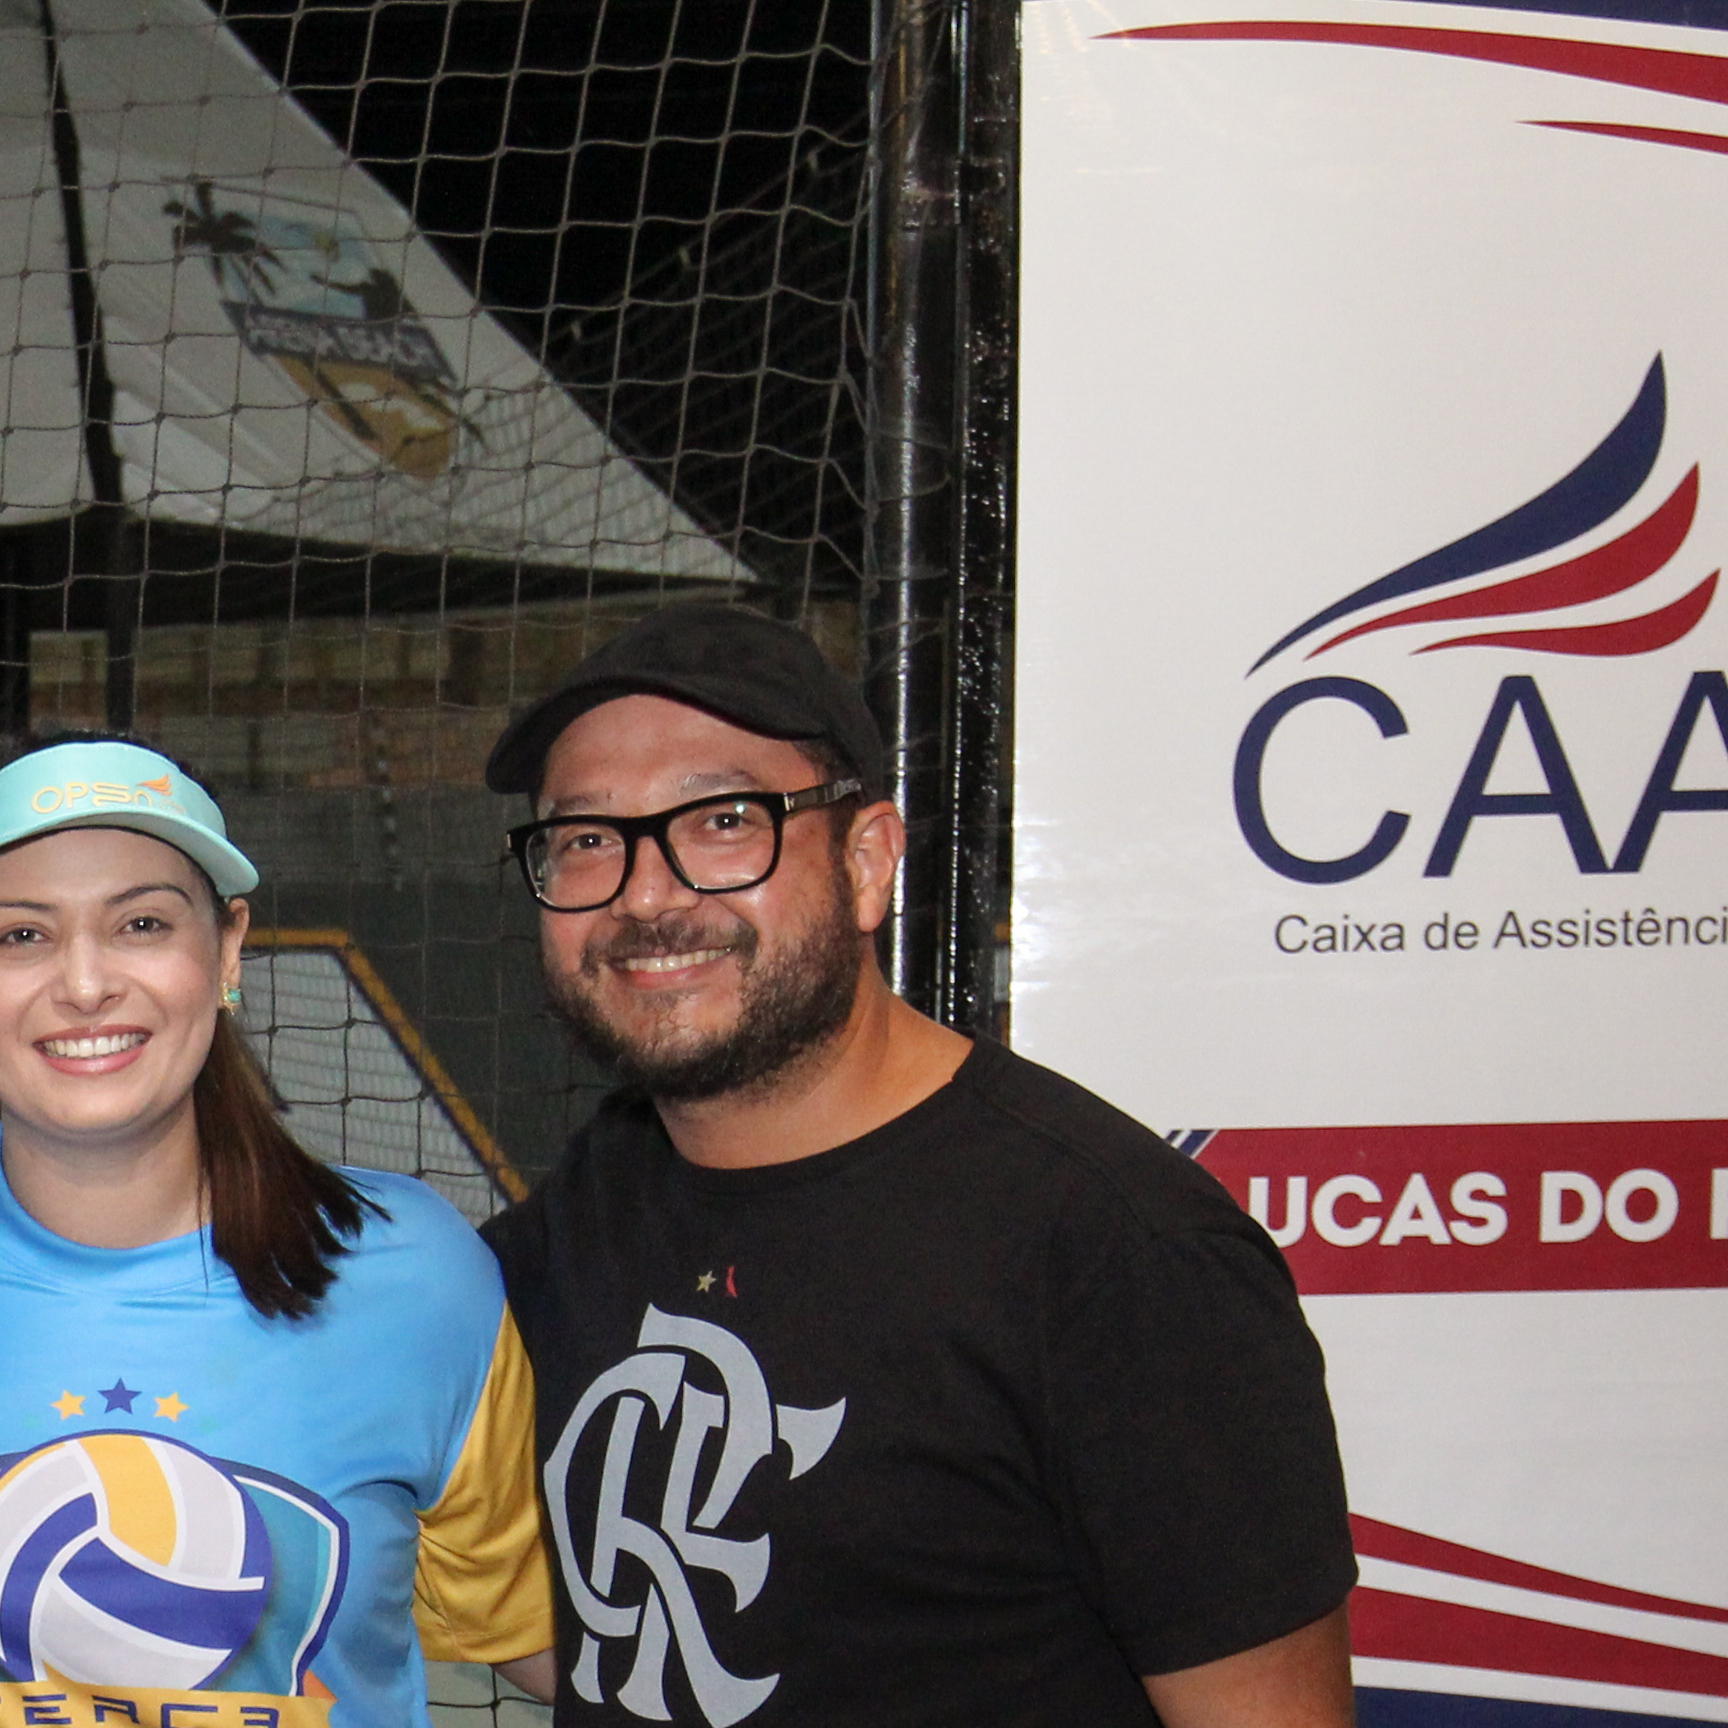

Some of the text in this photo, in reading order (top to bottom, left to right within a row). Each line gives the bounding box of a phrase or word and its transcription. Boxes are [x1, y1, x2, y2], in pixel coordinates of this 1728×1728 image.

[1273, 912, 1407, 955] Caixa
[1423, 911, 1481, 952] de
[1249, 1170, 1509, 1249] UCAS
[1539, 1167, 1680, 1244] DO
